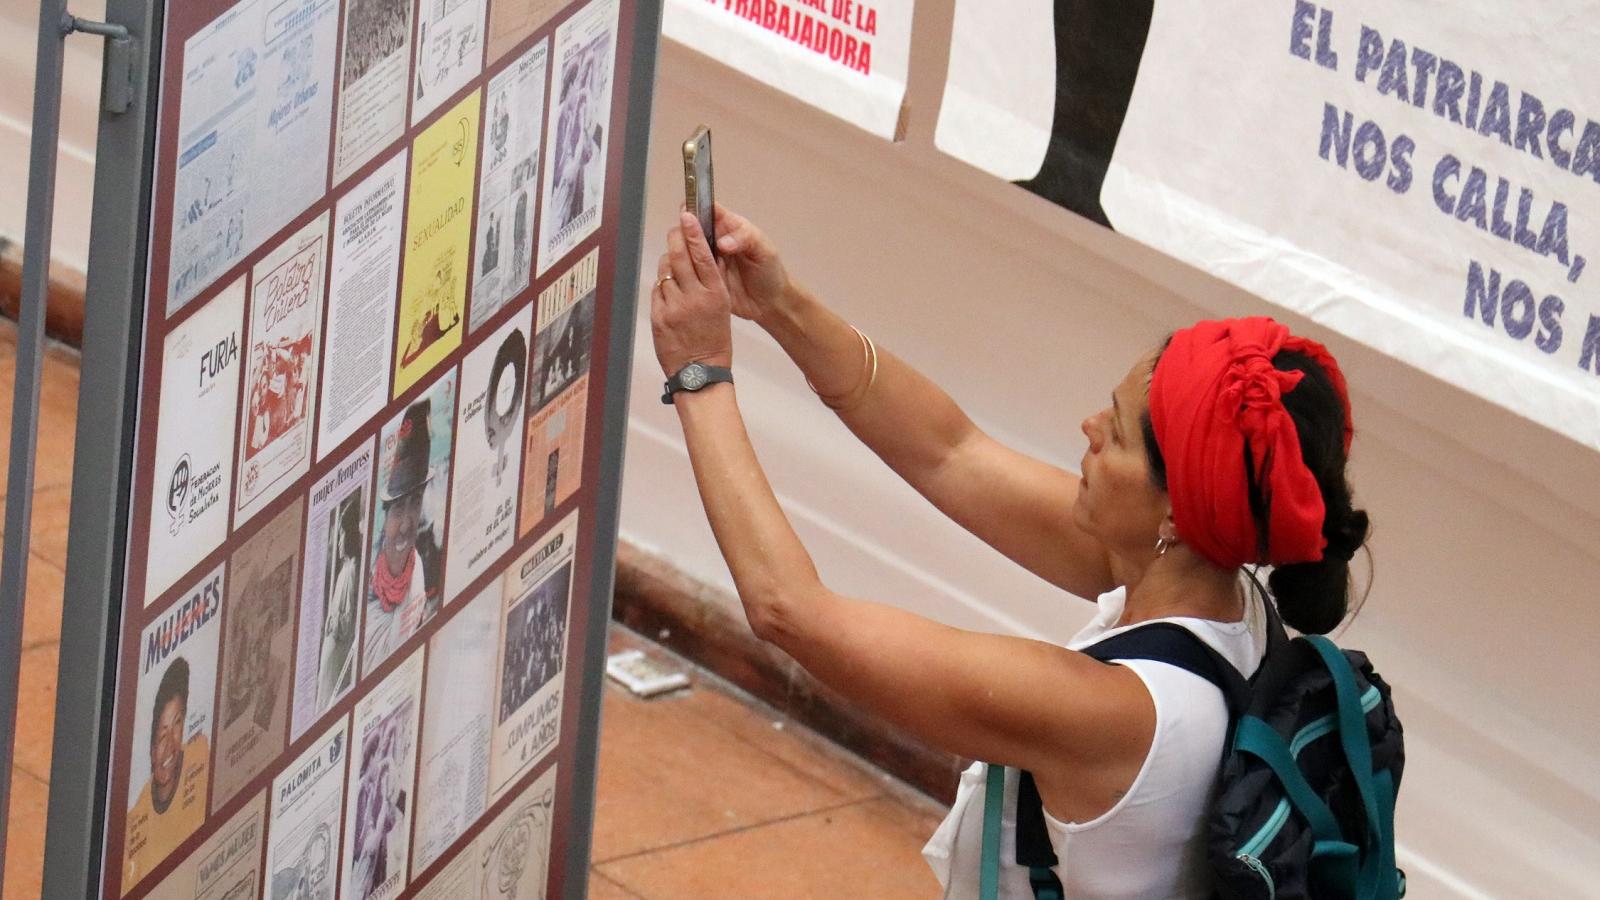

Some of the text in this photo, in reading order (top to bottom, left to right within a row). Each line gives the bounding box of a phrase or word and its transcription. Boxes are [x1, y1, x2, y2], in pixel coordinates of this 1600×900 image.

[831, 0, 853, 25] DE
[856, 4, 877, 36] LA
[1289, 0, 1338, 70] EL
[412, 196, 465, 251] SEXUALIDAD
[1318, 102, 1587, 283] NOS CALLA,
[1463, 260, 1566, 354] NOS
[199, 331, 238, 387] FURIA
[145, 575, 220, 674] MUJERES
[280, 756, 322, 803] PALOMITA
